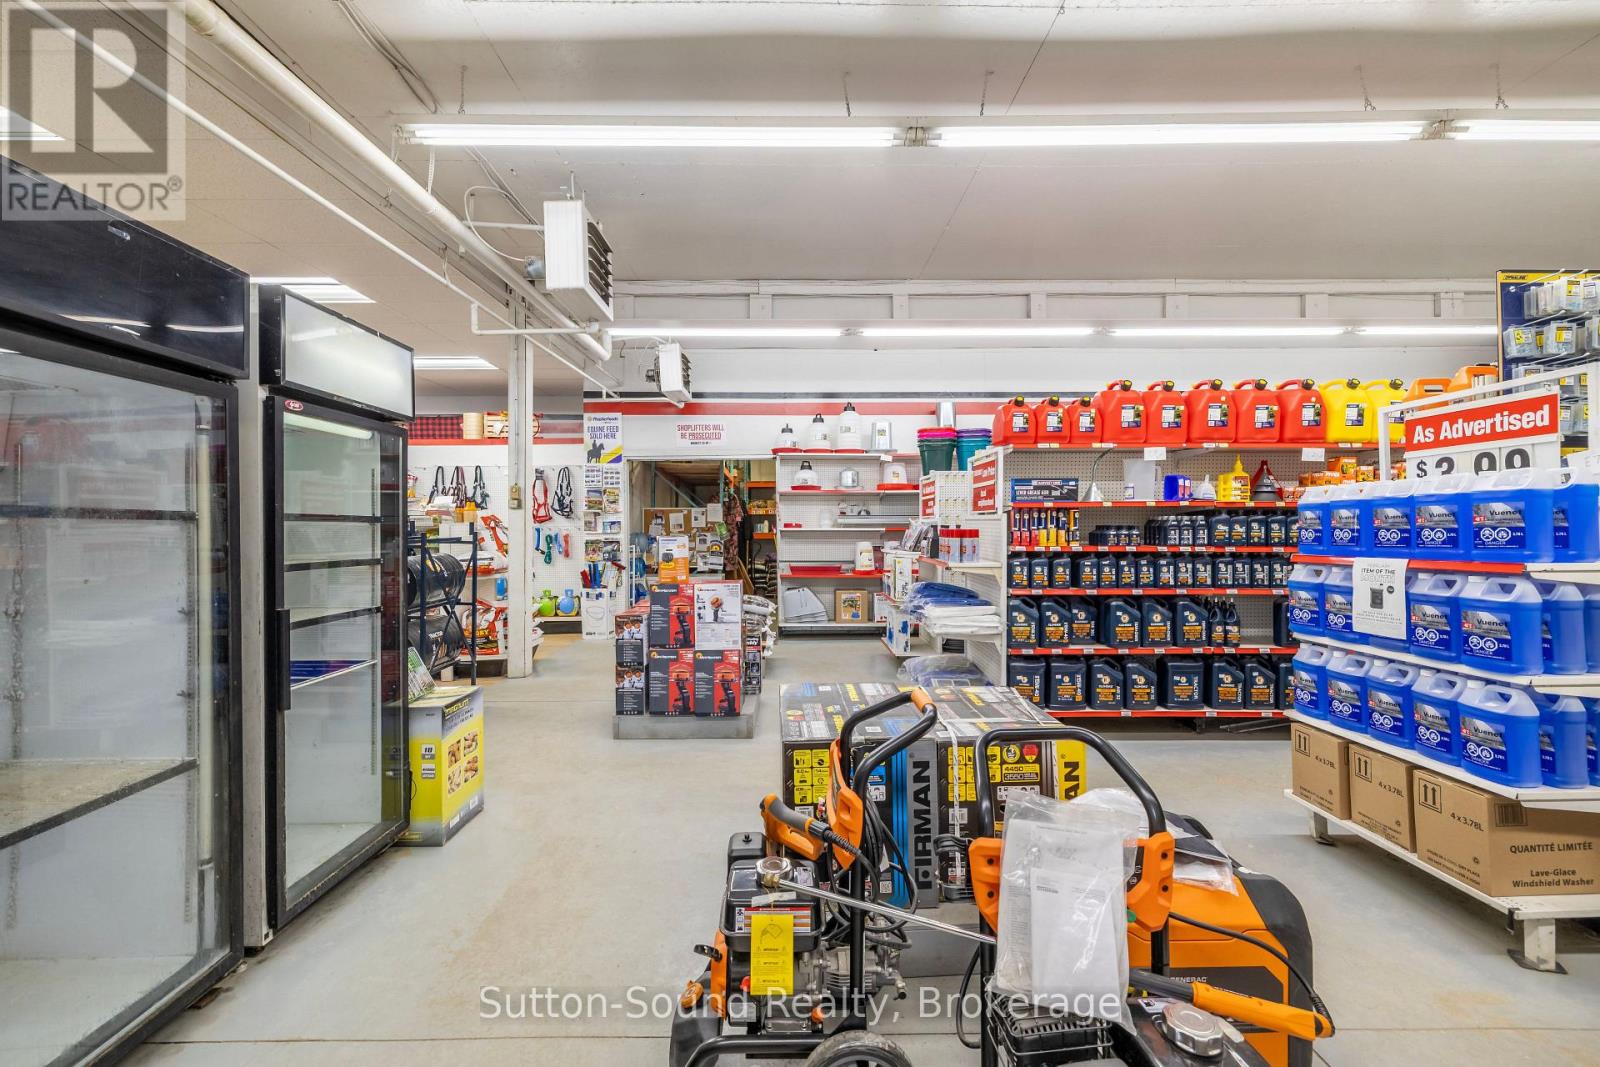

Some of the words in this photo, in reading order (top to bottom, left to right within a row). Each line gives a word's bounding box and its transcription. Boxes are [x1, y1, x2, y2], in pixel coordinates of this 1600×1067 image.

[1413, 425, 1435, 444] As
[1439, 404, 1550, 440] Advertised
[1387, 784, 1404, 797] 3.78L
[912, 760, 932, 889] FIRMAN
[1462, 816, 1484, 832] 3.78L
[1509, 842, 1555, 853] QUANTITÉ
[1557, 841, 1593, 852] LIMITÉE
[1530, 868, 1577, 877] Lave-Glace
[1512, 878, 1561, 888] Windshield
[1562, 877, 1594, 887] Washer
